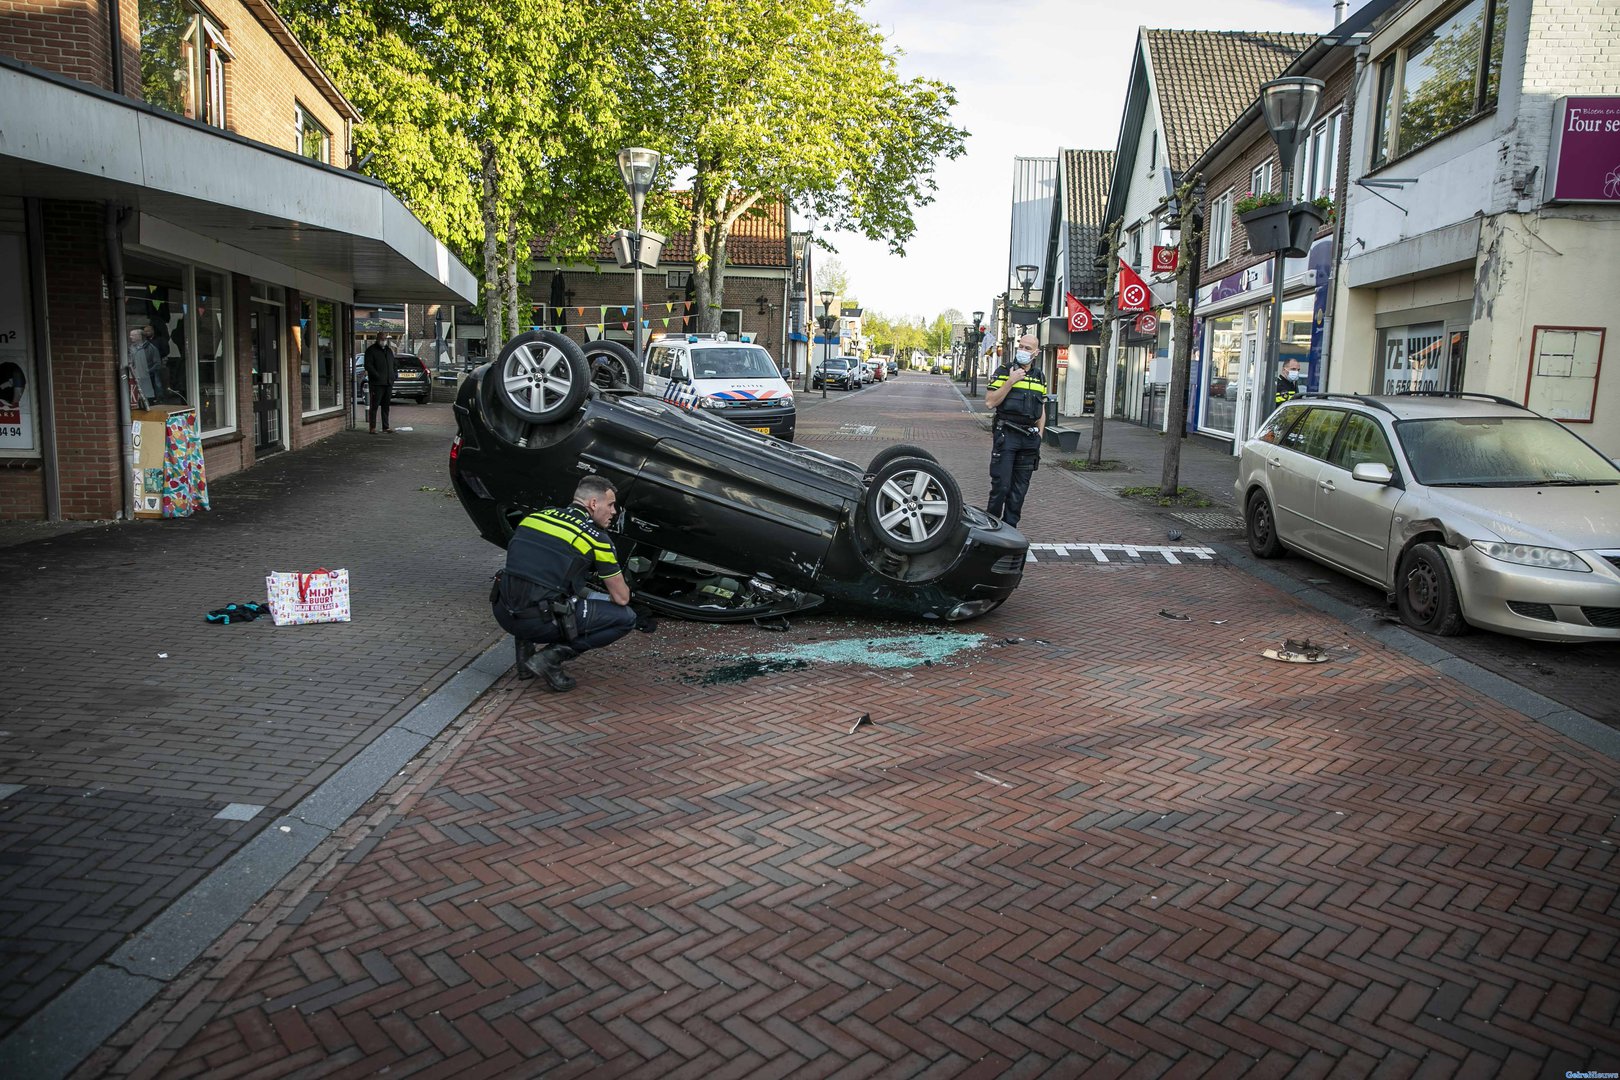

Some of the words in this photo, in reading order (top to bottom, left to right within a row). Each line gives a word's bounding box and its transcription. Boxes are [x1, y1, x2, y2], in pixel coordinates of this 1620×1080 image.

[1567, 108, 1602, 132] Four
[1604, 119, 1620, 132] se
[1387, 338, 1403, 370] TE
[10, 427, 21, 436] 94
[309, 587, 334, 597] MIJN
[309, 596, 334, 604] BUURT
